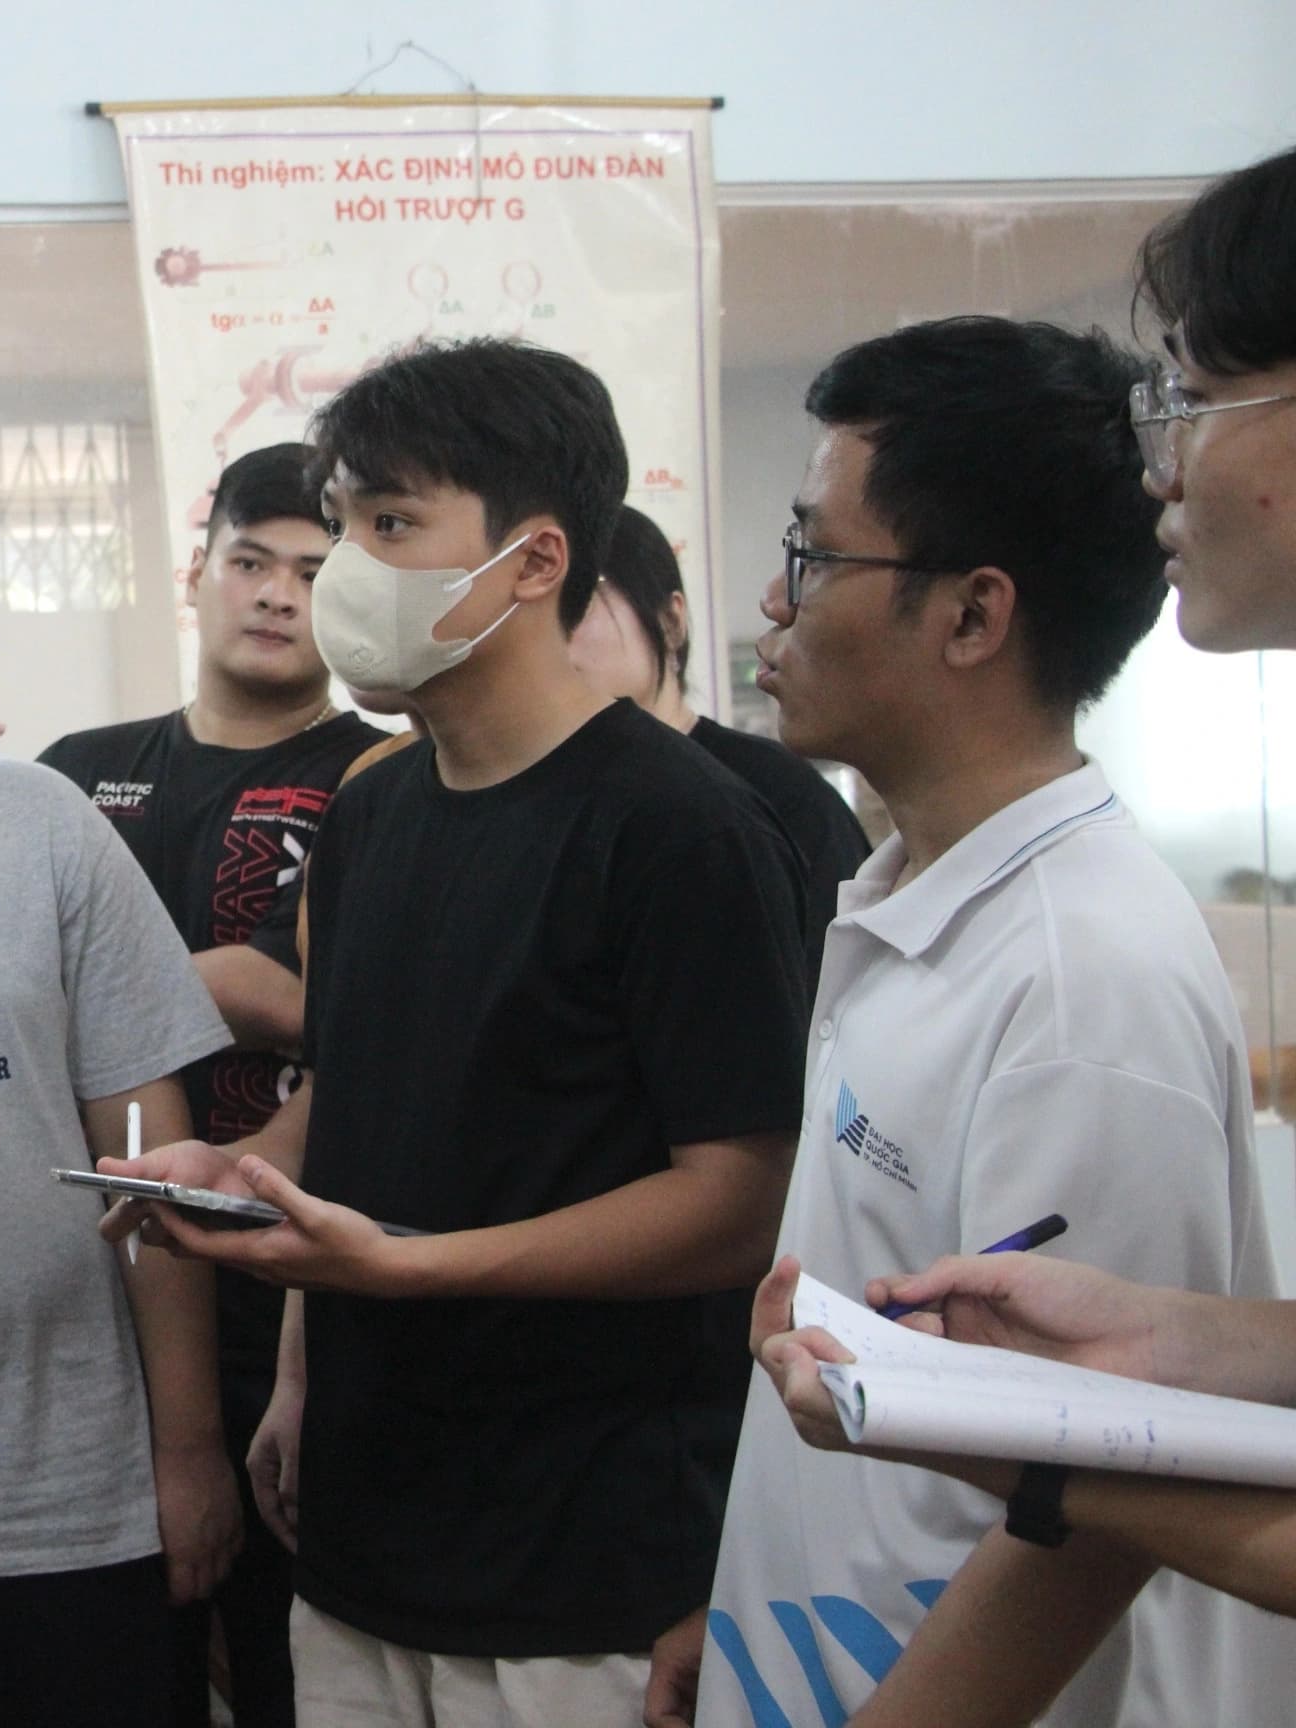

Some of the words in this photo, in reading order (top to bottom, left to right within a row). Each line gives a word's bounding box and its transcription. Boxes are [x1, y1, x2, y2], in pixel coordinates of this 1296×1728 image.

[159, 162, 203, 185] Thí
[211, 160, 326, 189] nghiệm:
[334, 154, 394, 182] XÁC
[404, 157, 473, 185] ĐỊNH
[482, 152, 525, 180] MÔ
[534, 157, 596, 180] ĐUN
[605, 152, 665, 178] ĐÀN
[504, 197, 526, 221] G
[96, 781, 154, 796] PACIFIC
[92, 794, 144, 808] COAST
